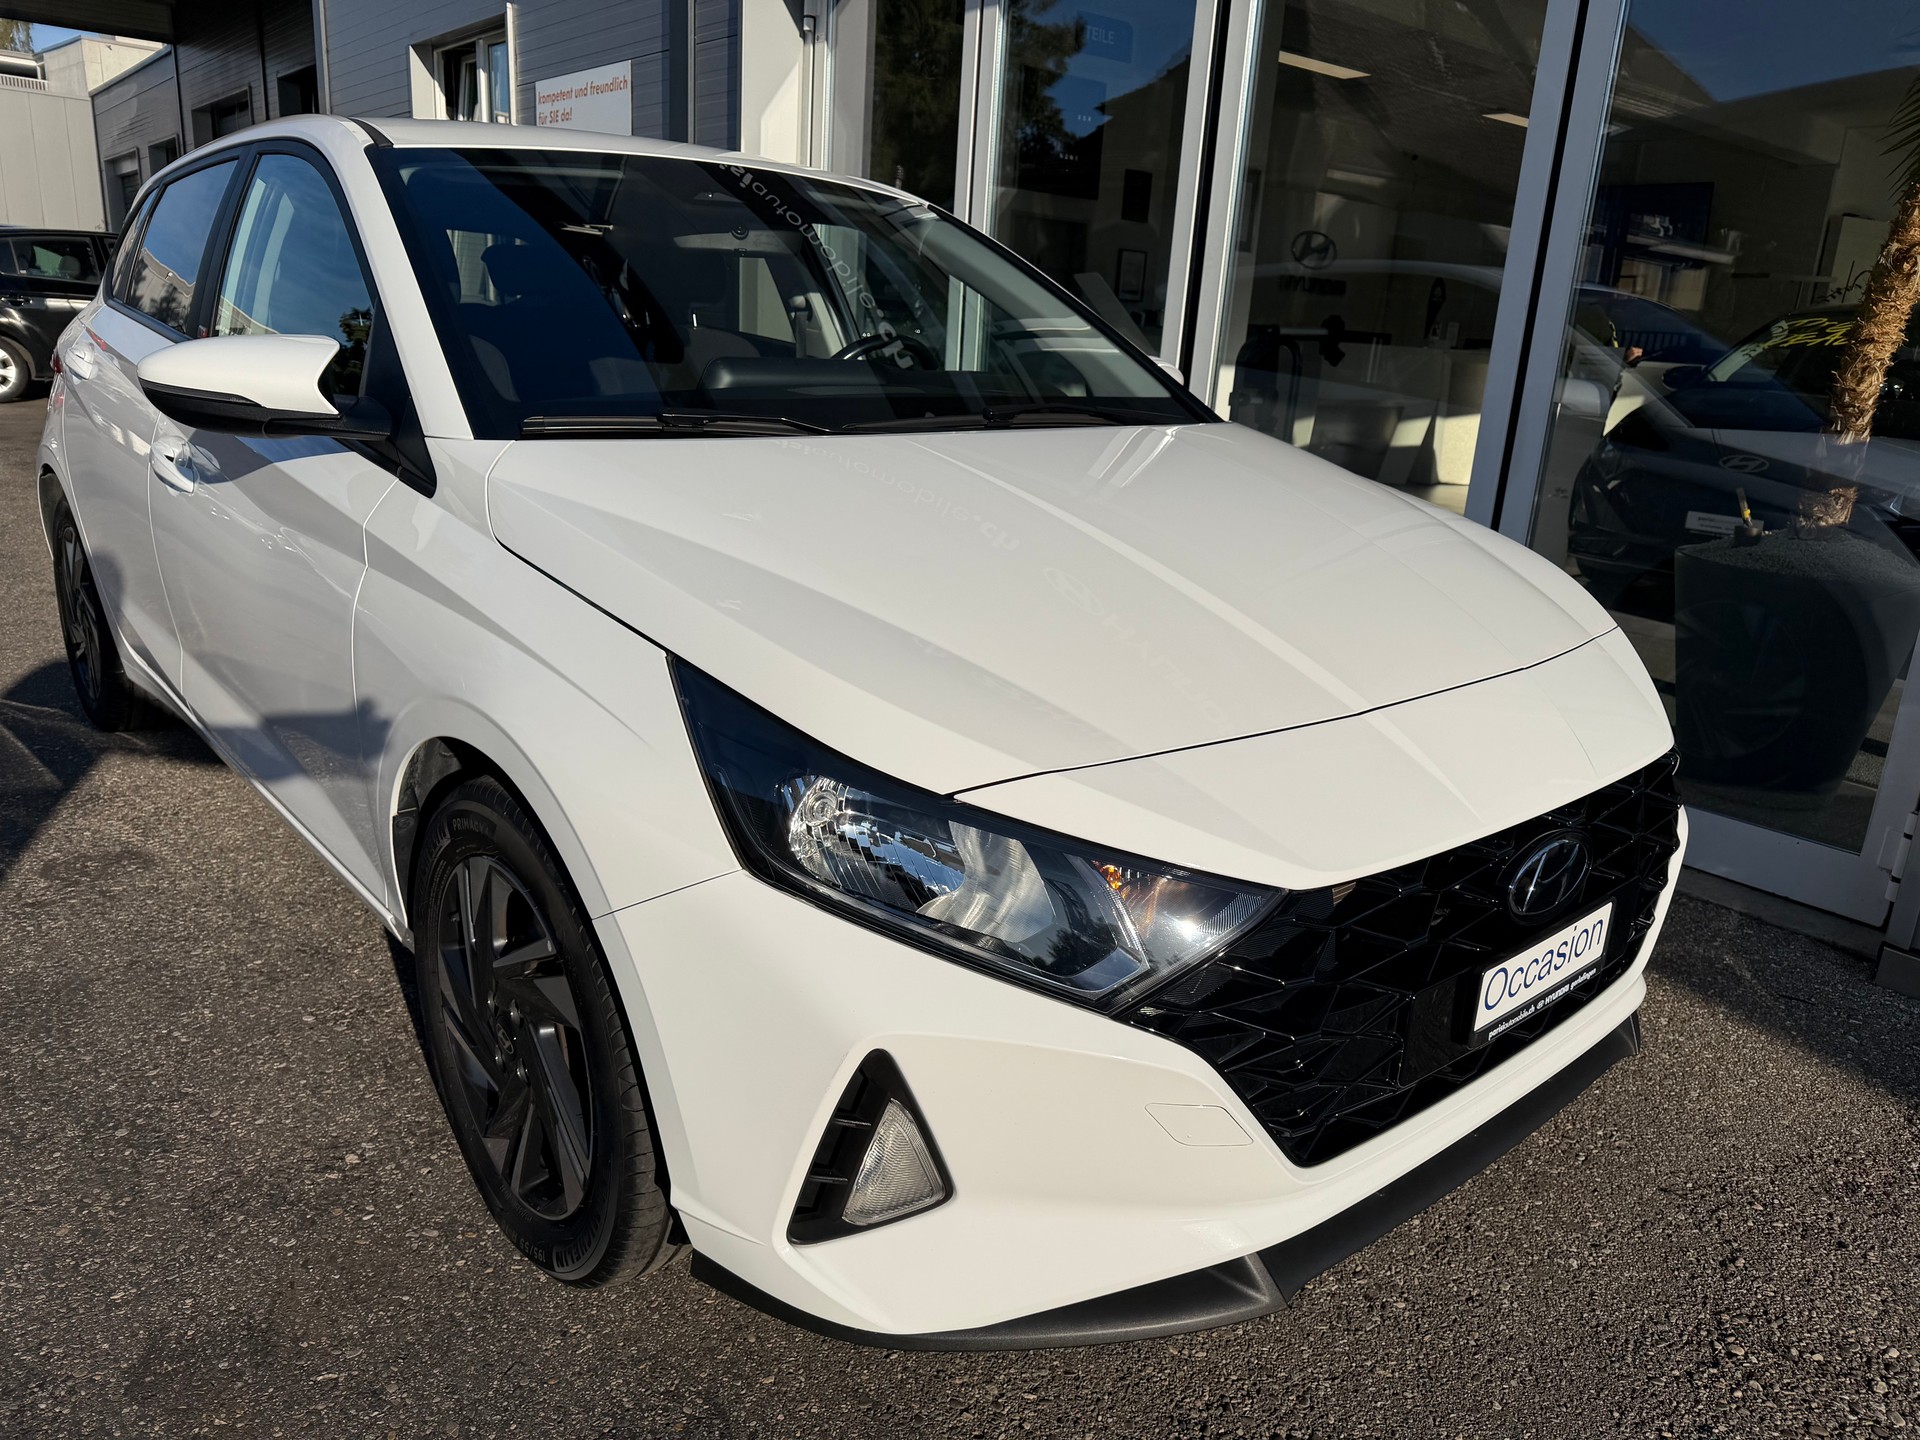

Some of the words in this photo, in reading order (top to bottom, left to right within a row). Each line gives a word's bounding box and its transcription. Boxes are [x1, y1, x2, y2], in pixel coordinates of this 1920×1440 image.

[538, 88, 573, 106] kompetent
[575, 82, 588, 98] und
[590, 75, 628, 95] freundlich
[538, 112, 548, 125] für
[549, 110, 559, 123] SIE
[561, 107, 572, 121] da!
[1484, 919, 1604, 1011] Occasion
[1544, 983, 1570, 1005] HYUNDAI
[519, 1238, 546, 1263] 195/55
